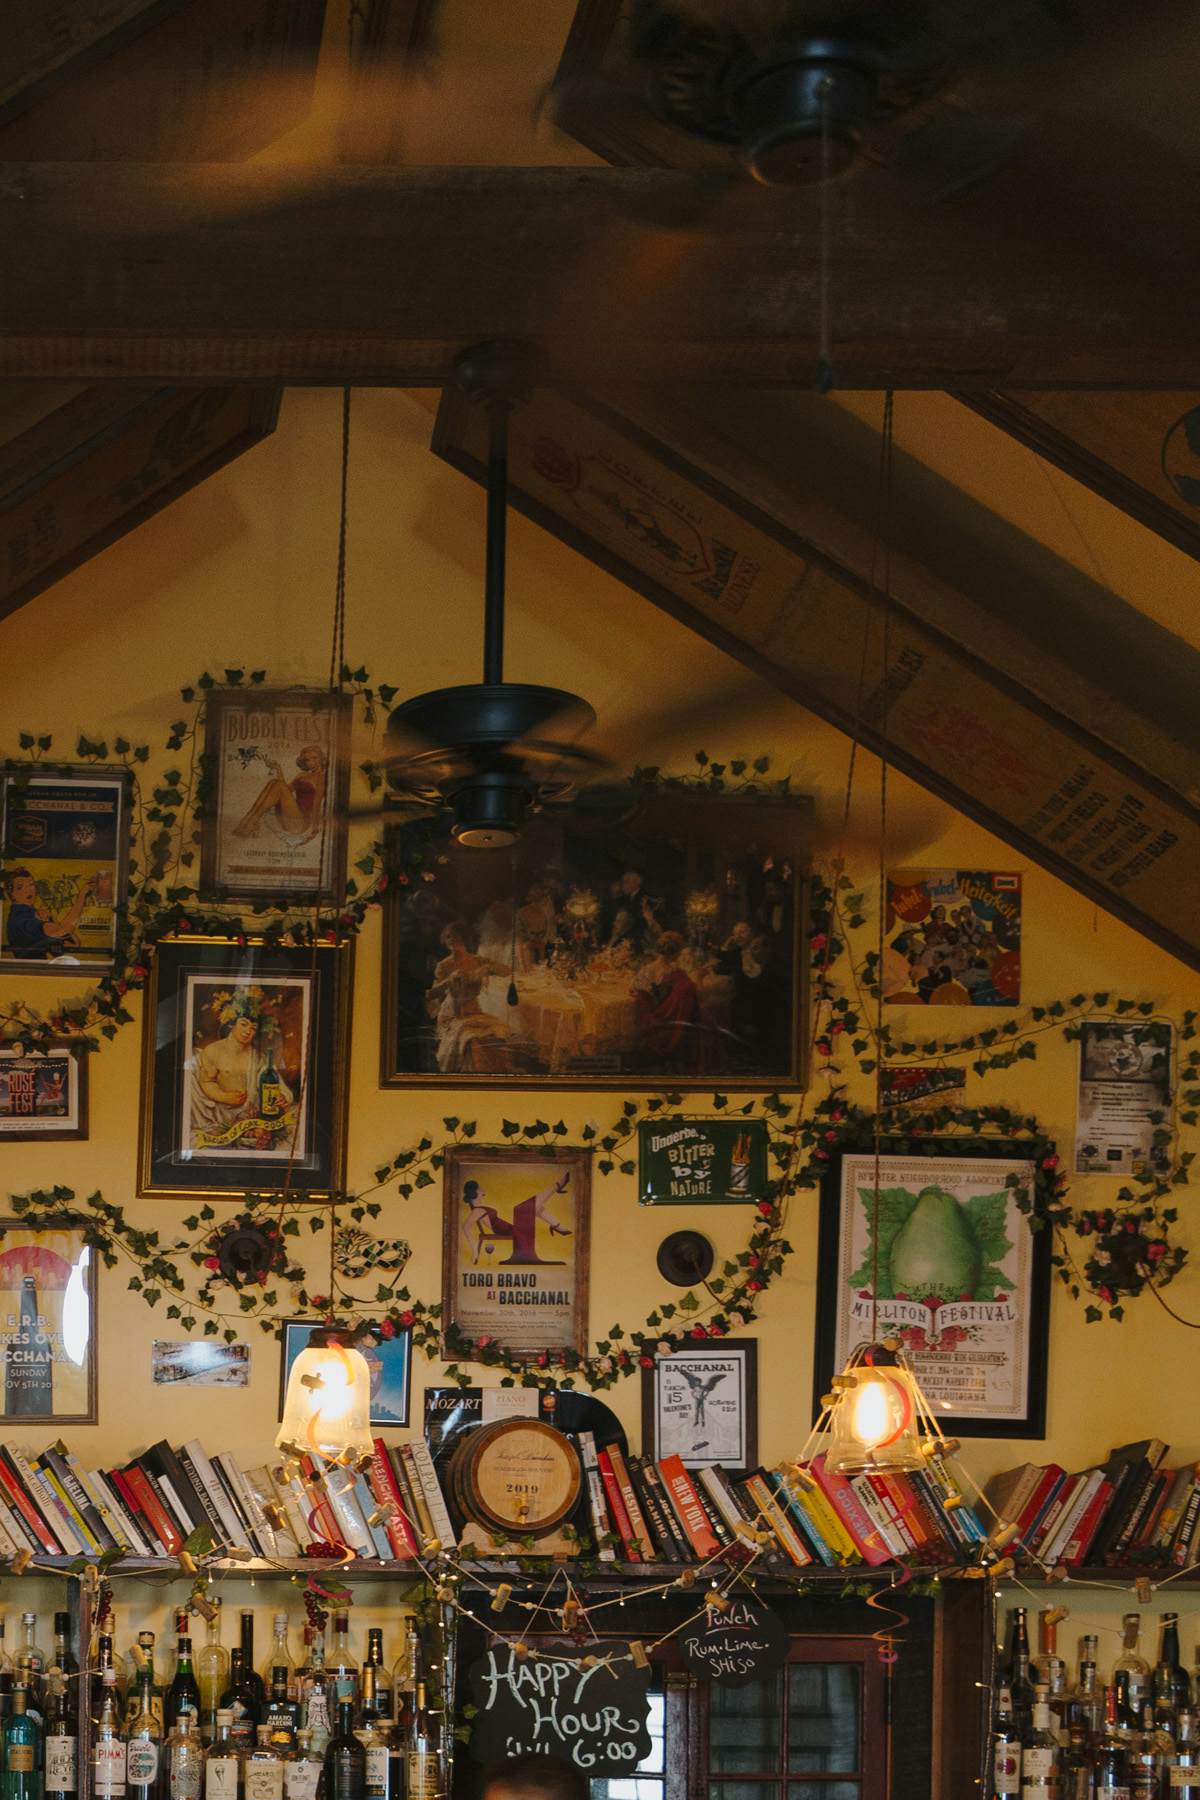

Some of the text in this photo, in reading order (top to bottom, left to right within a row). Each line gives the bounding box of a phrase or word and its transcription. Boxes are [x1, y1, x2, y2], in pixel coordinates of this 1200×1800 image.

[9, 1092, 35, 1113] FEST
[668, 1143, 715, 1165] BITTER
[672, 1165, 711, 1179] by
[670, 1180, 712, 1196] NATURE
[462, 1273, 537, 1287] TORO BRAVO
[487, 1291, 570, 1305] AT BACCHANAL
[7, 1315, 51, 1327] E.R.B.
[852, 1301, 1016, 1325] MIRLITON FESTIVAL
[35, 1333, 64, 1344] OVE
[11, 1369, 48, 1377] SUNDAY
[665, 1364, 734, 1373] BACCHANAL
[426, 1398, 482, 1410] MOZART
[412, 1440, 439, 1494] POLPO
[506, 1483, 539, 1494] 2019
[673, 1482, 695, 1507] NEW
[622, 1485, 642, 1525] BESTIA
[683, 1504, 706, 1533] YORK
[482, 1651, 605, 1710] HAPPY
[529, 1696, 640, 1741] HOUR
[572, 1738, 637, 1767] 6:00
